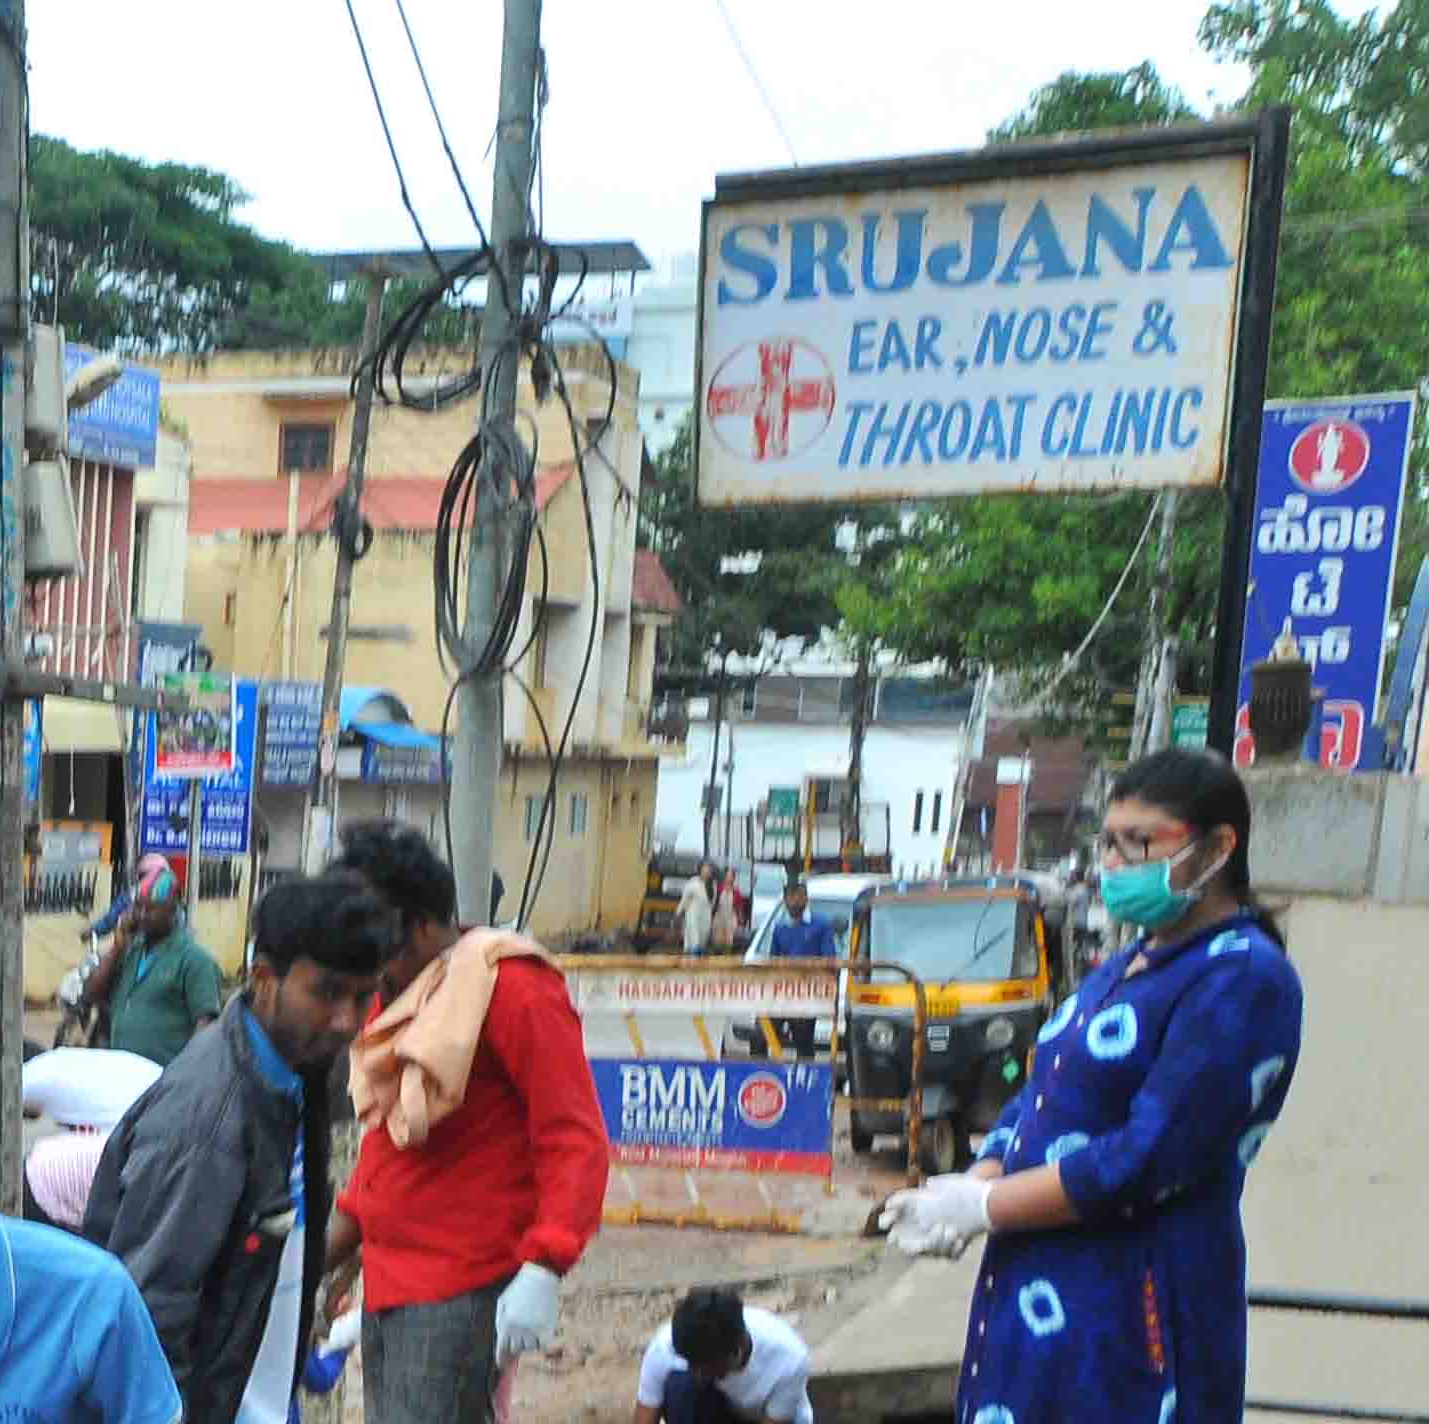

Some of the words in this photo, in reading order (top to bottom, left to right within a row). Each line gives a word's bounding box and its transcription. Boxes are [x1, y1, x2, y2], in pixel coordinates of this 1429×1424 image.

[716, 184, 1237, 306] SRUJANA
[973, 303, 1118, 370] NOSE
[1132, 301, 1178, 358] &
[839, 394, 1034, 467] THROAT
[1041, 386, 1204, 455] CLINIC
[620, 1064, 726, 1107] BMM
